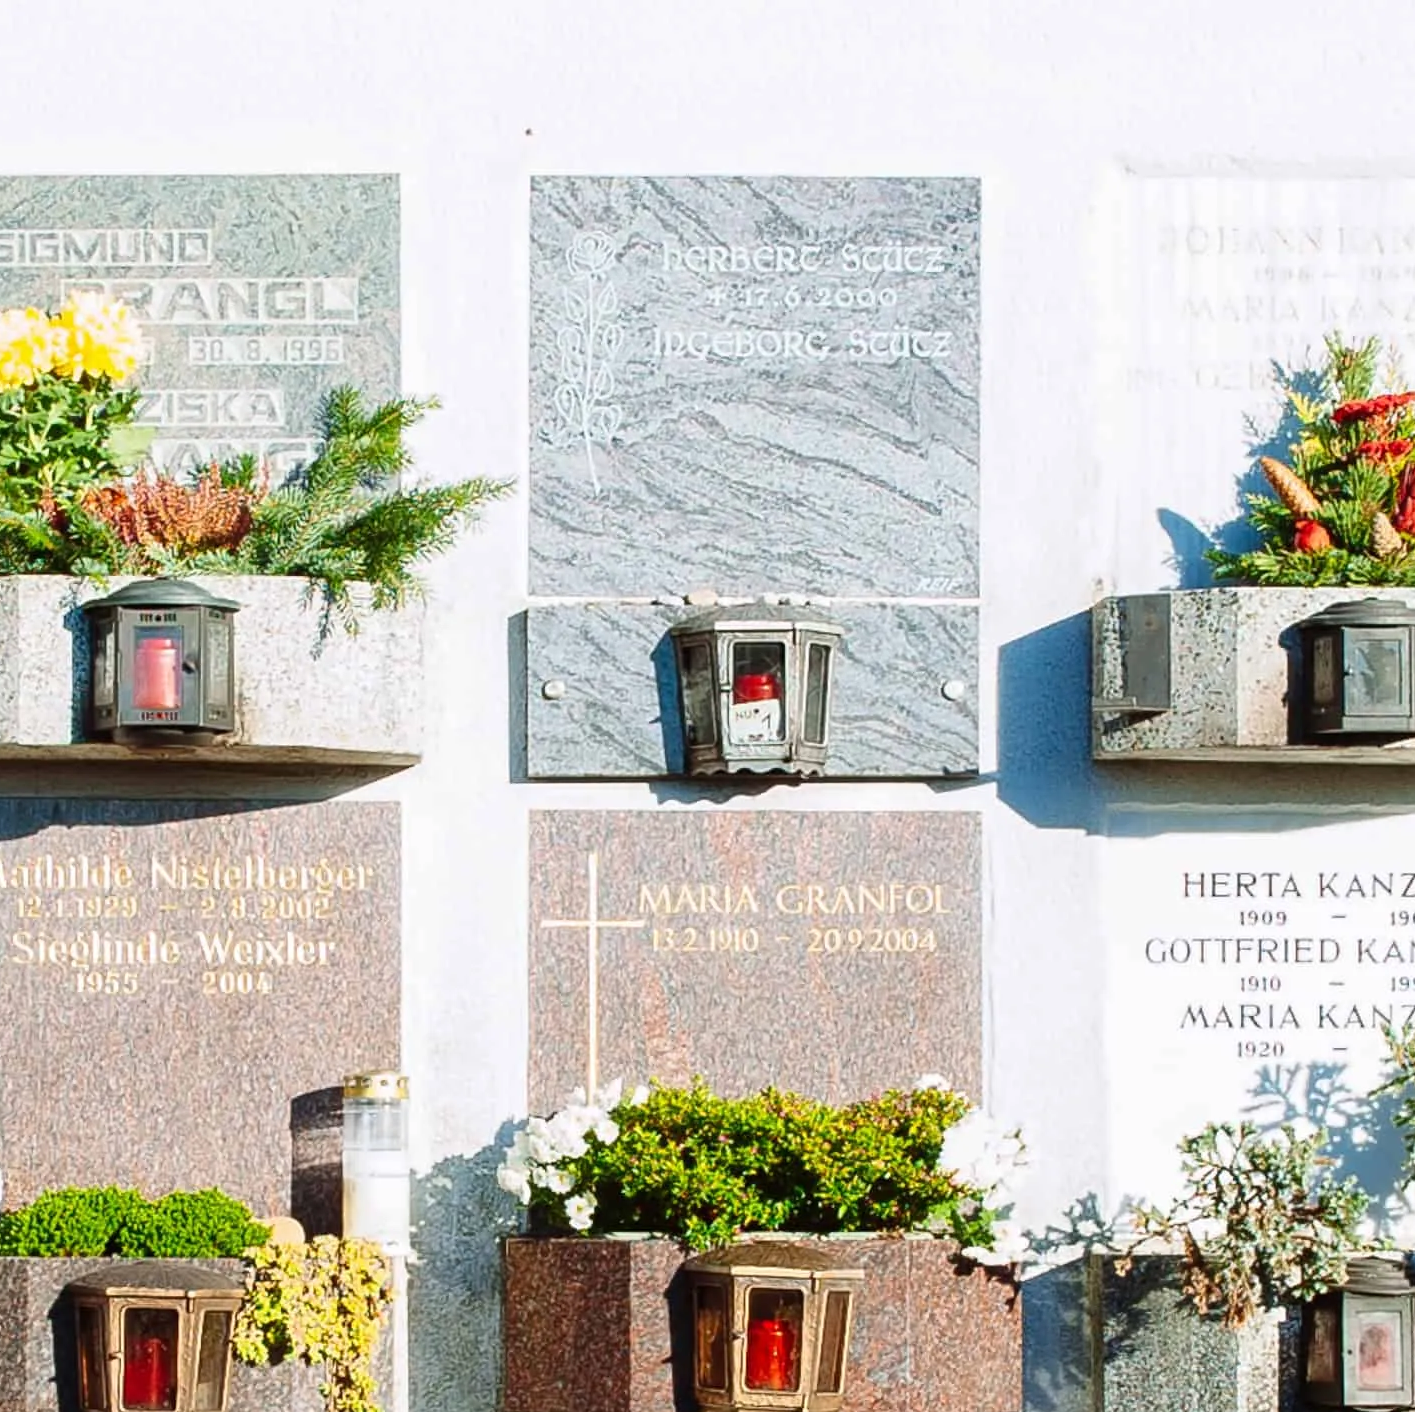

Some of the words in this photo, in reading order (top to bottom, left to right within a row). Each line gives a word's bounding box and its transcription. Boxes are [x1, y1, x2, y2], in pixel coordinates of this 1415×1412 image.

[1158, 226, 1323, 256] JOHANN
[841, 238, 946, 272] STÜTZ
[1180, 295, 1300, 322] MARIA
[283, 339, 342, 363] 1996
[653, 326, 830, 361] INGEBORG
[849, 324, 952, 357] STÜTZ
[1183, 873, 1302, 898] HERTA
[639, 885, 759, 915] MARIA
[775, 885, 951, 915] GRANFOL
[1239, 910, 1288, 926] 1909
[12, 932, 180, 969] Sieglinde
[197, 931, 336, 966] Weixler
[652, 928, 759, 952] 13.2.1910
[1144, 938, 1341, 964] GOTTFRIED
[76, 972, 138, 994] 1955
[201, 972, 273, 994] 2004
[1239, 976, 1282, 992] 1910
[1179, 1004, 1301, 1029] MARIA
[1236, 1042, 1285, 1058] 1920
